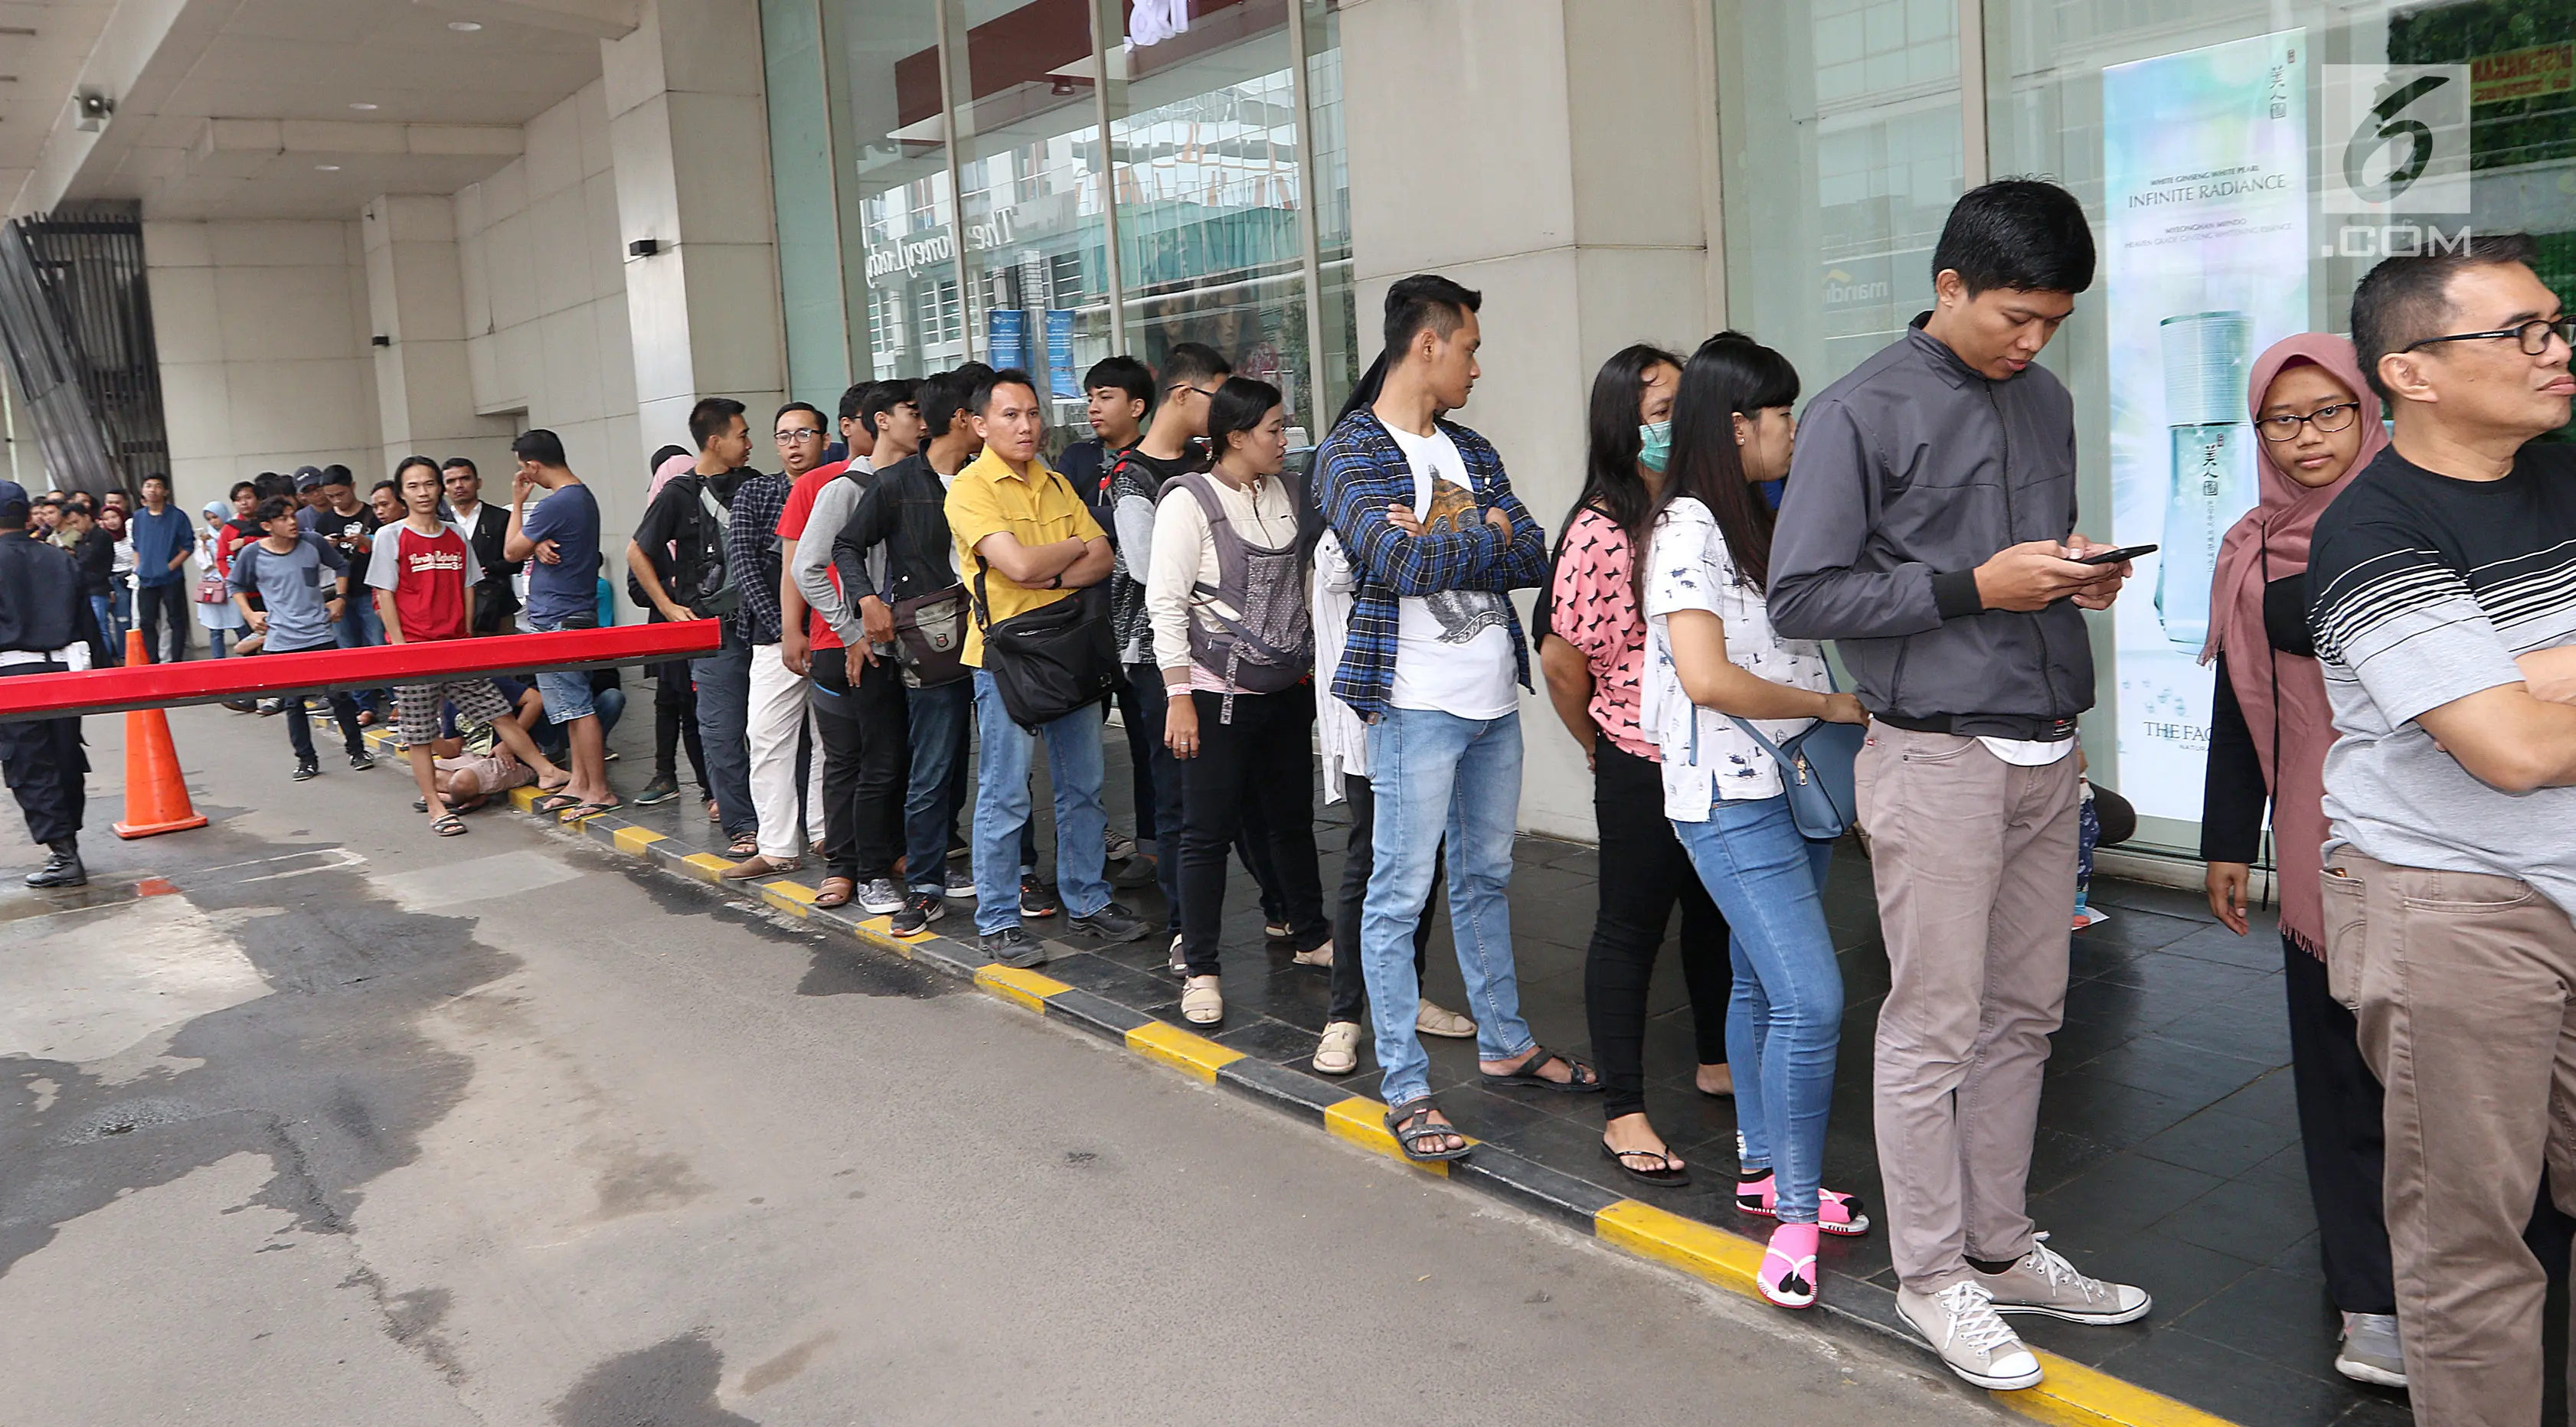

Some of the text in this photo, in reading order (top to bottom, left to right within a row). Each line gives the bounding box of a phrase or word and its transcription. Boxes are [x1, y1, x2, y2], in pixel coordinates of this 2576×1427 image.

[2150, 165, 2260, 185] WHITE GINSENG WHITE PEARL
[2129, 174, 2286, 208] INFINITE RADIANCE
[2143, 721, 2180, 738] THE
